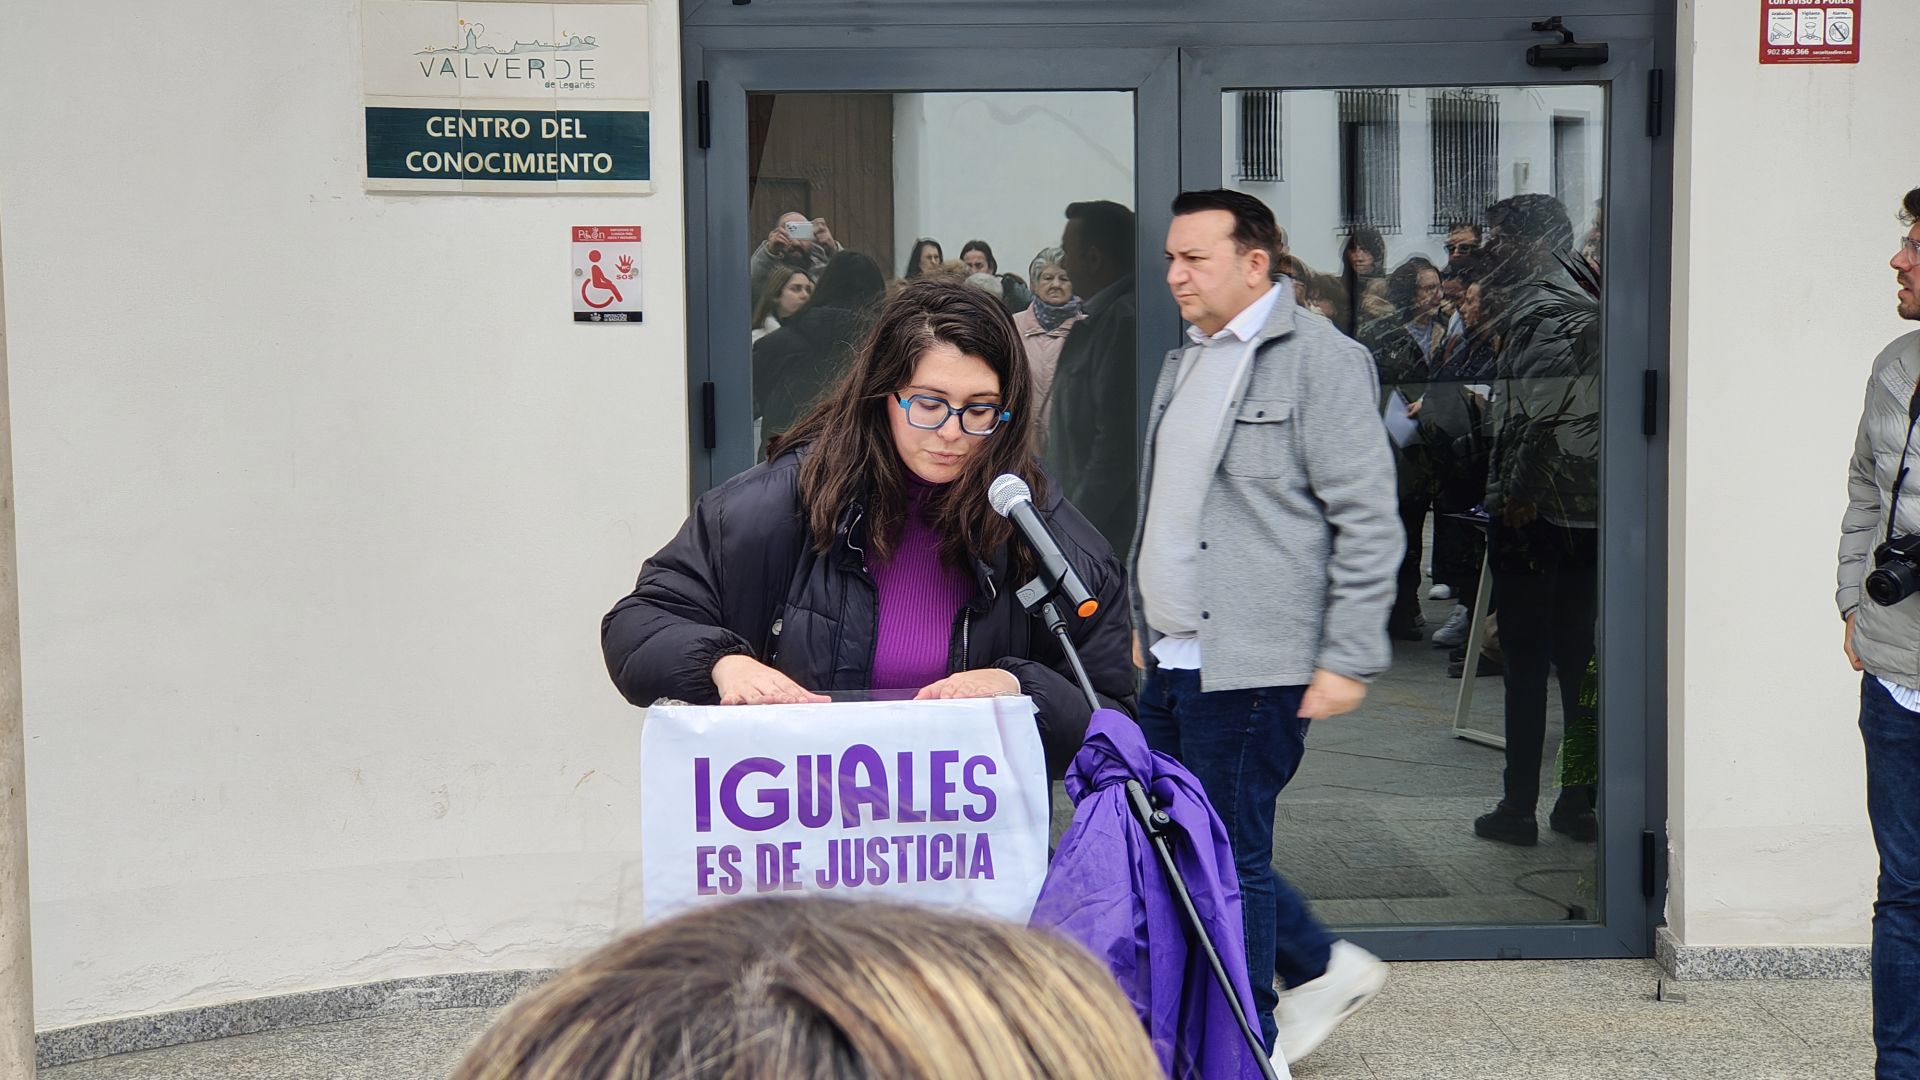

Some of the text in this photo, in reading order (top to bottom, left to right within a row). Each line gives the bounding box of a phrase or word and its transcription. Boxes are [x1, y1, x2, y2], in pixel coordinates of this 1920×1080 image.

[420, 57, 596, 80] VALVERDE
[545, 80, 596, 91] de Leganés
[425, 116, 587, 139] CENTRO DEL
[405, 151, 613, 174] CONOCIMIENTO
[694, 743, 997, 832] IGUALES
[696, 832, 995, 895] ES DE JUSTICIA
